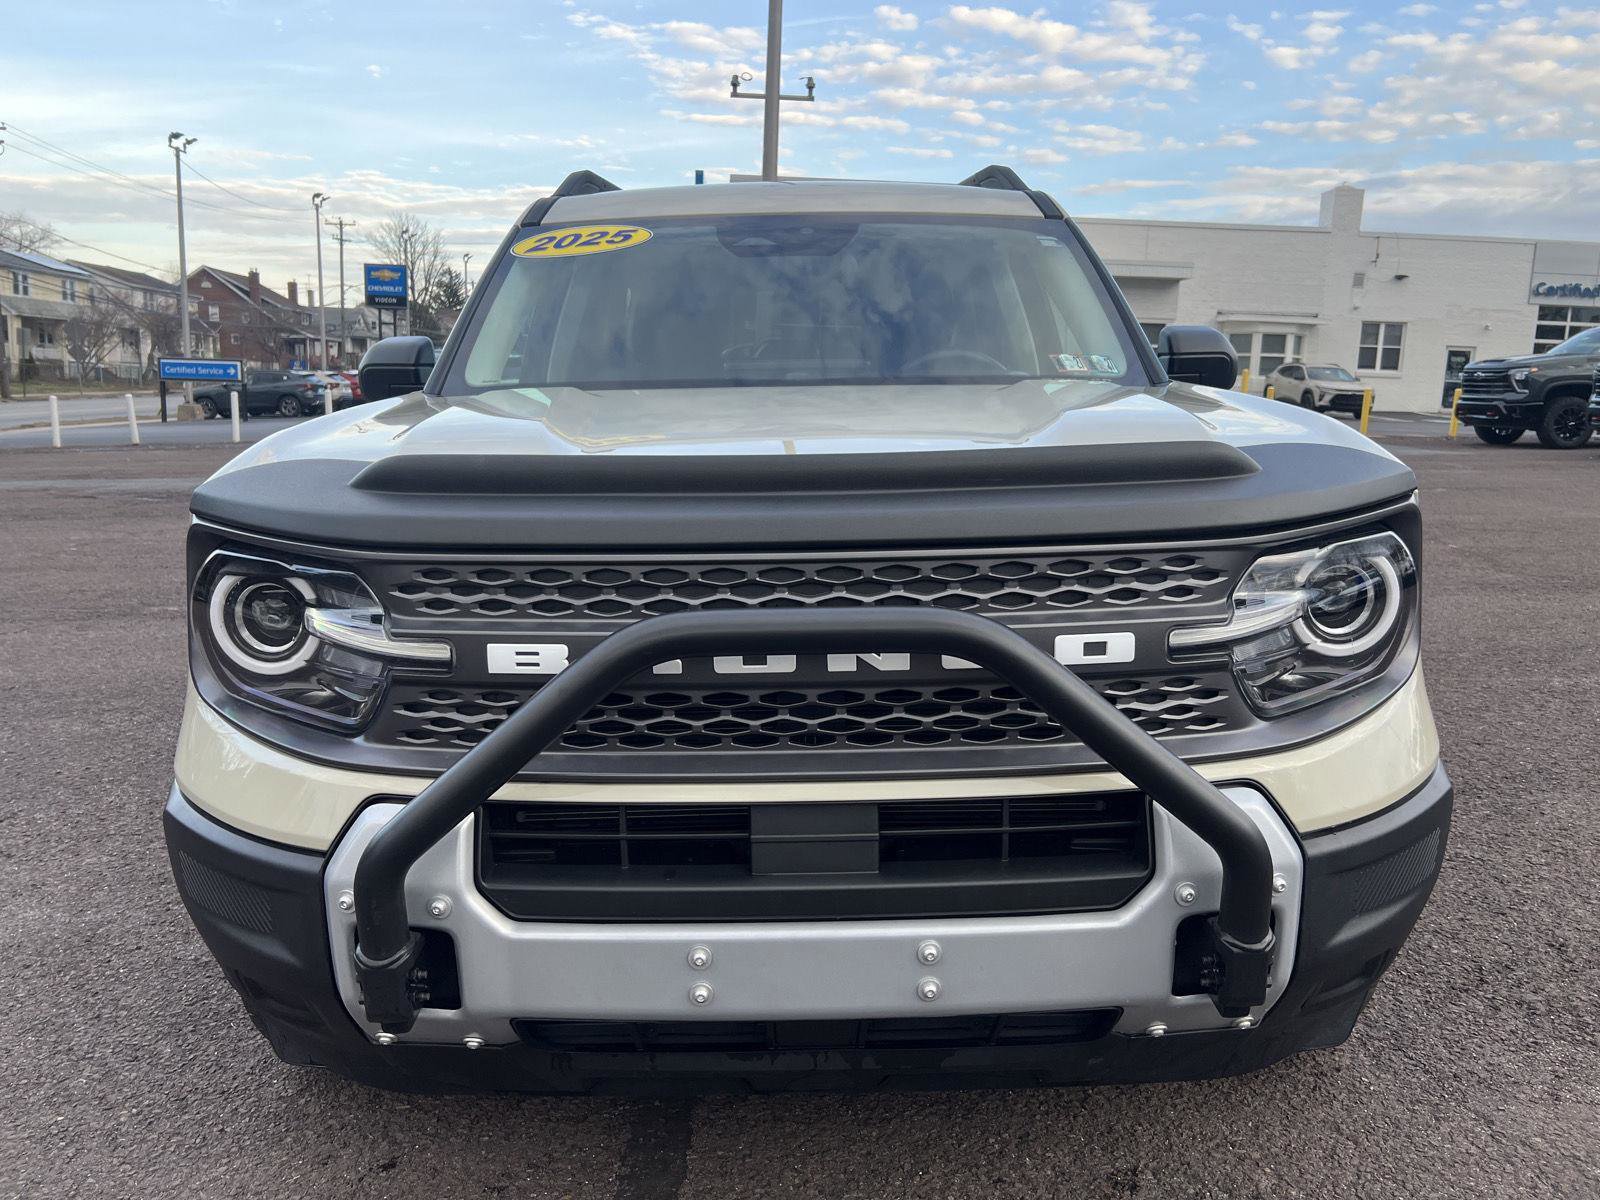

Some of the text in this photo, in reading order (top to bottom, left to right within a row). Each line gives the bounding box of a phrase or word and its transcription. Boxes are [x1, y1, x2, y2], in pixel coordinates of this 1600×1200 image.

[524, 229, 639, 254] 2025
[165, 366, 224, 375] Certified Service
